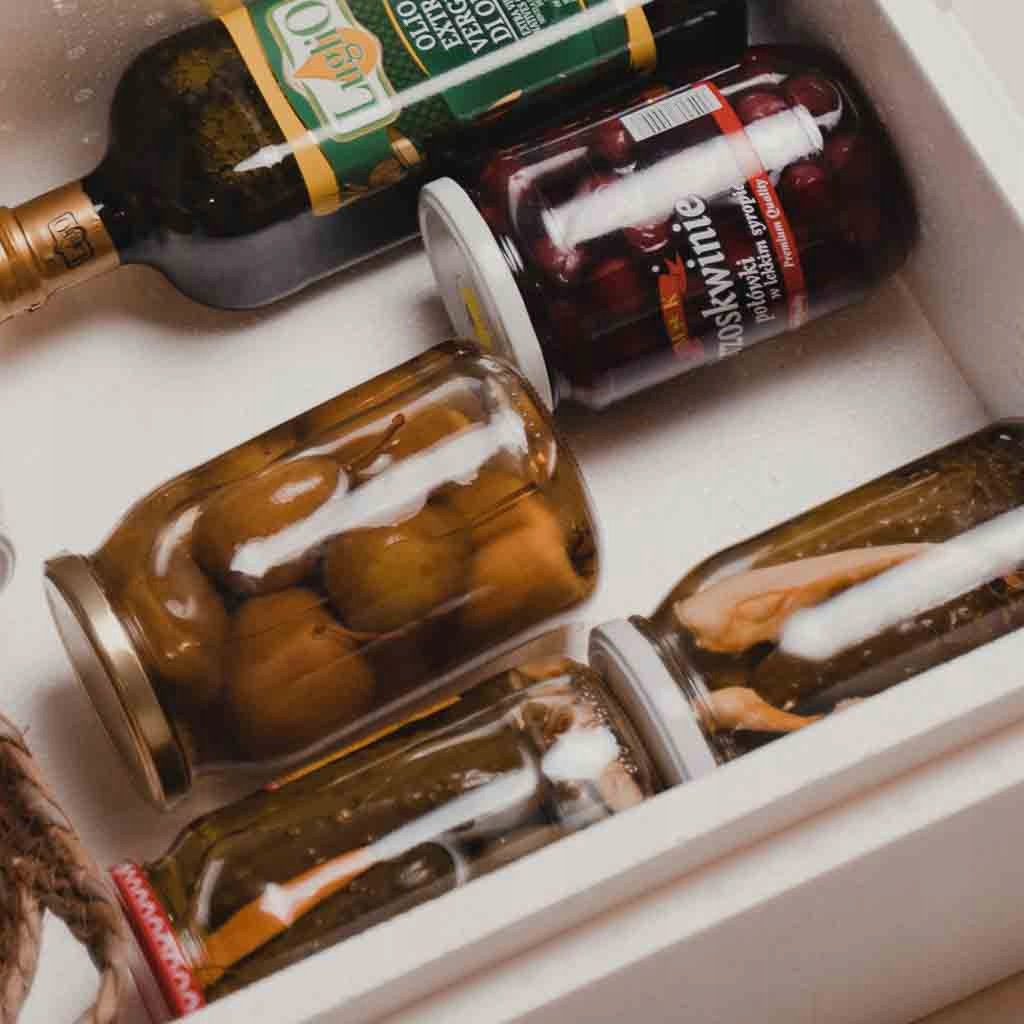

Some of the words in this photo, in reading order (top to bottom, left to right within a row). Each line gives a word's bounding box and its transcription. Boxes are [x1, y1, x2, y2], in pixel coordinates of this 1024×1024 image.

[397, 0, 437, 51] OLIO
[484, 17, 514, 45] DI
[755, 178, 780, 219] Quality
[755, 239, 778, 286] lekkim
[774, 221, 796, 268] Premium
